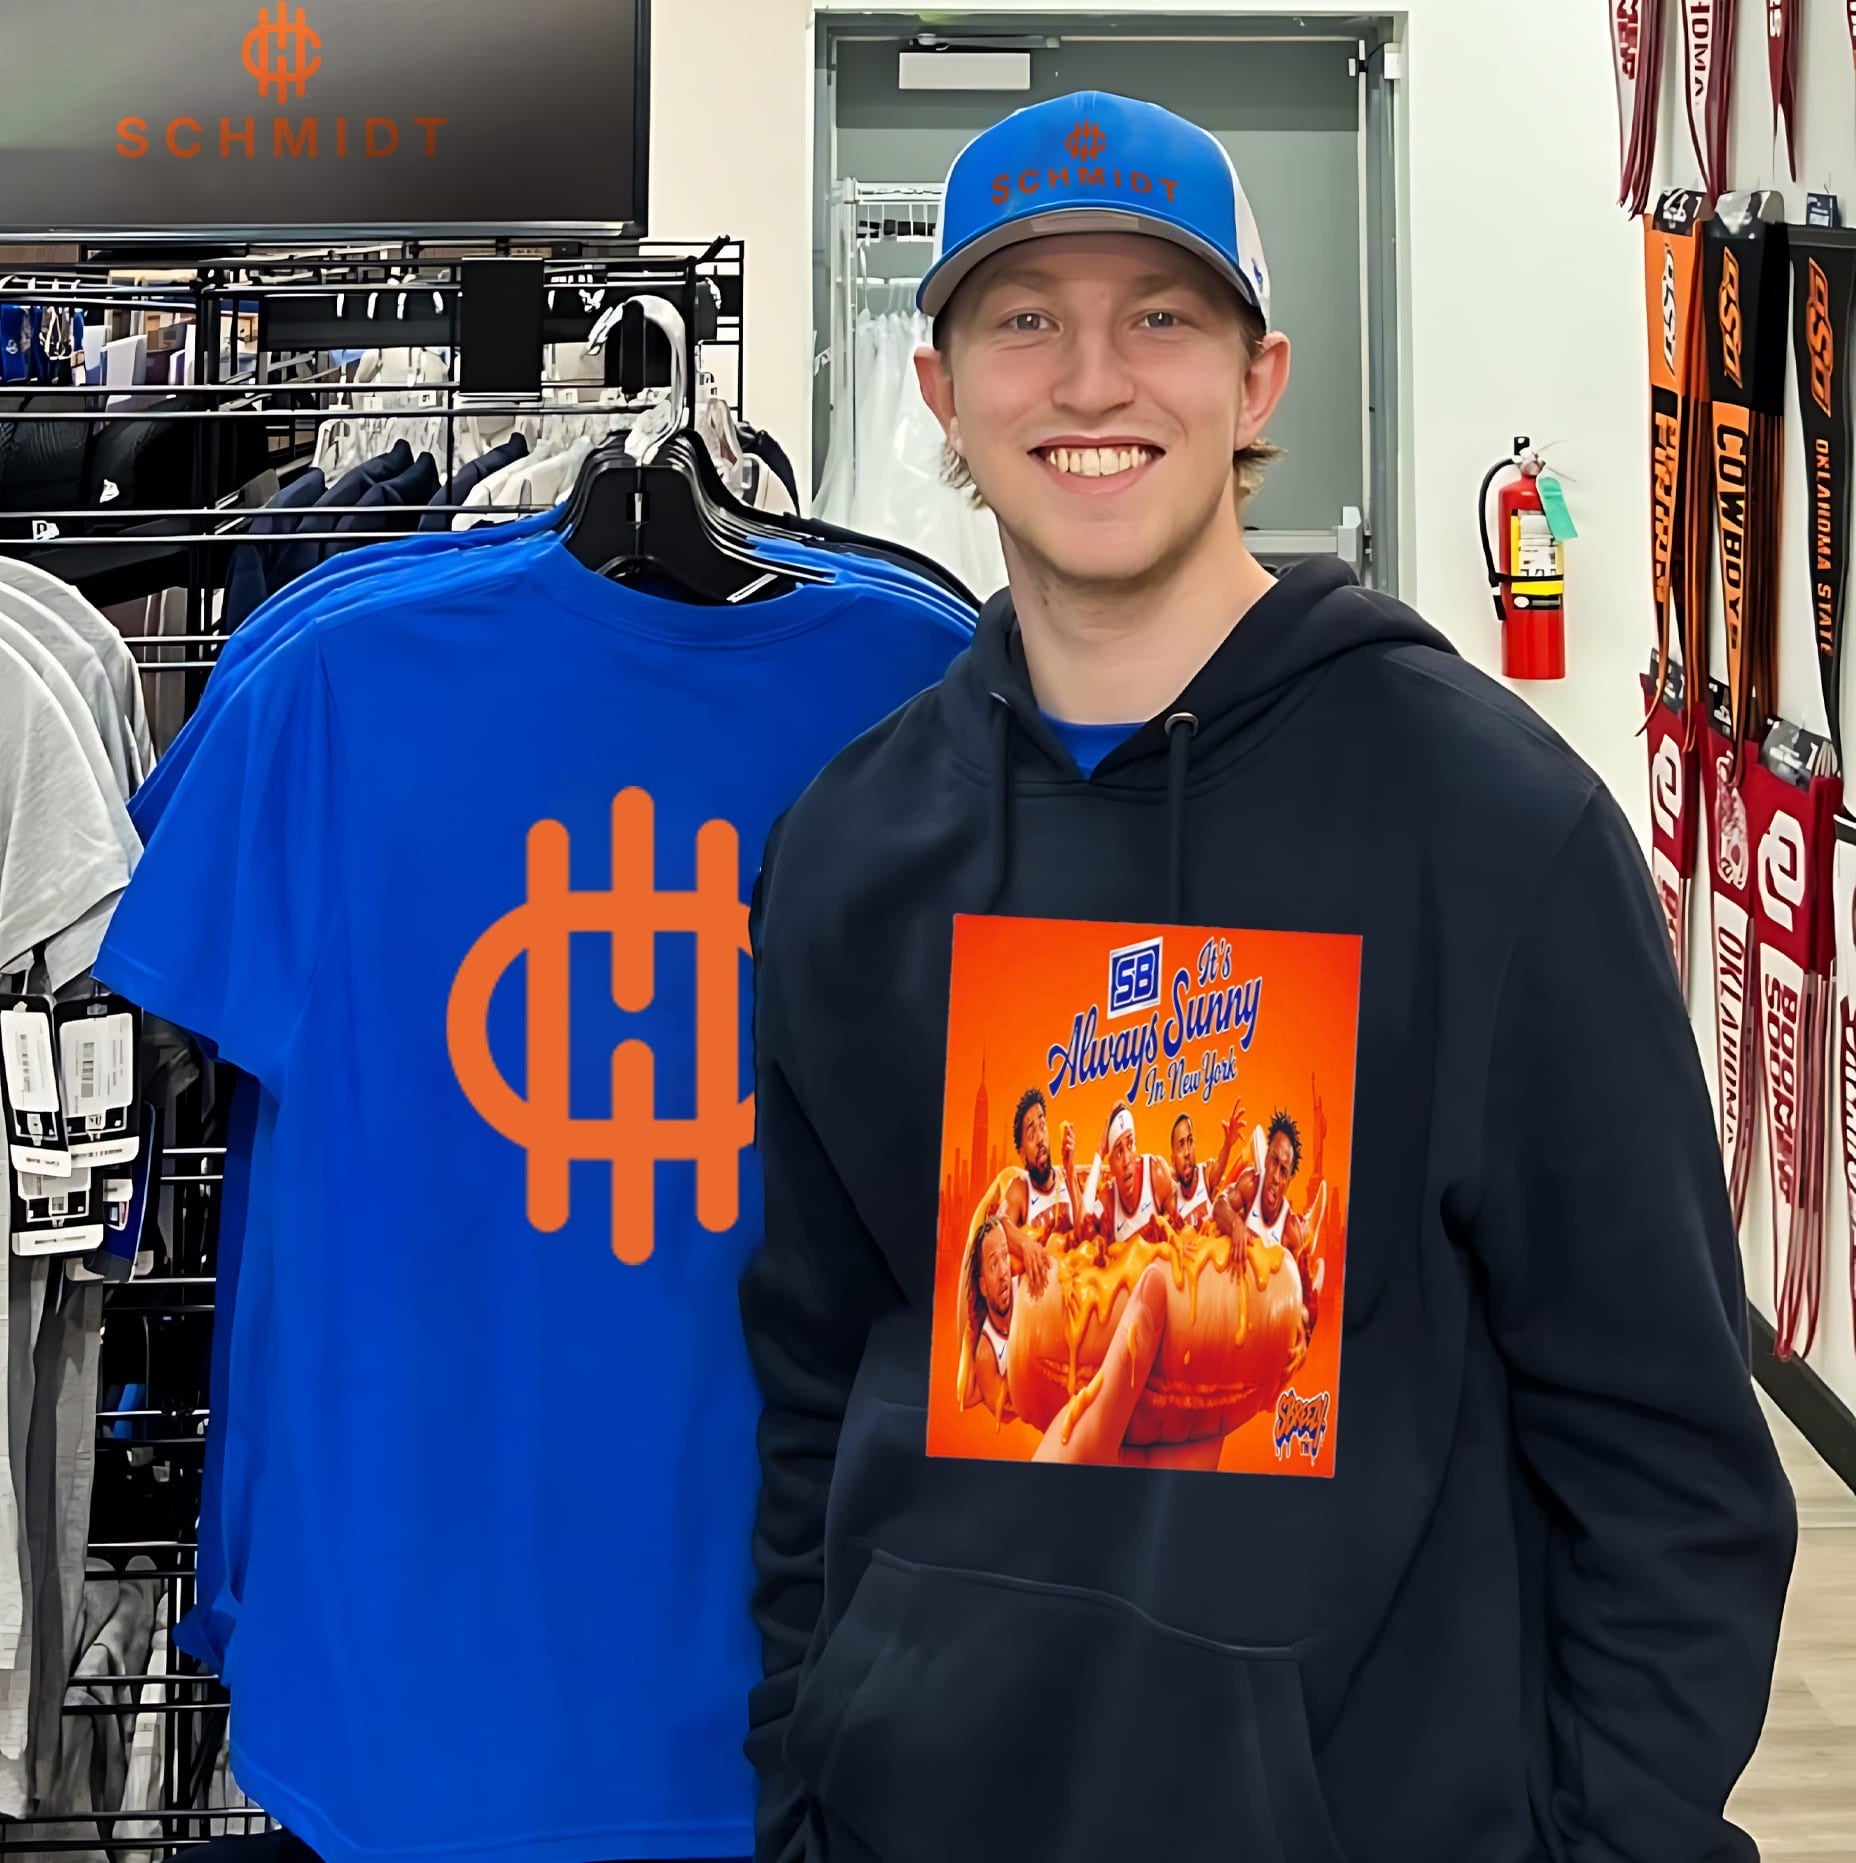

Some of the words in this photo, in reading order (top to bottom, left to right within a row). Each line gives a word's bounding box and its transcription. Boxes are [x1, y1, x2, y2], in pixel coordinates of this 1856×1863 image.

[116, 116, 448, 158] SCHMIDT
[991, 166, 1179, 205] SCHMIDT
[1113, 949, 1157, 1004] SB
[1198, 936, 1231, 987] It's
[1048, 1003, 1158, 1103] Always
[1163, 968, 1263, 1059] Sunny
[1145, 1064, 1165, 1107] In
[1168, 1057, 1201, 1102] New
[1200, 1046, 1239, 1103] York
